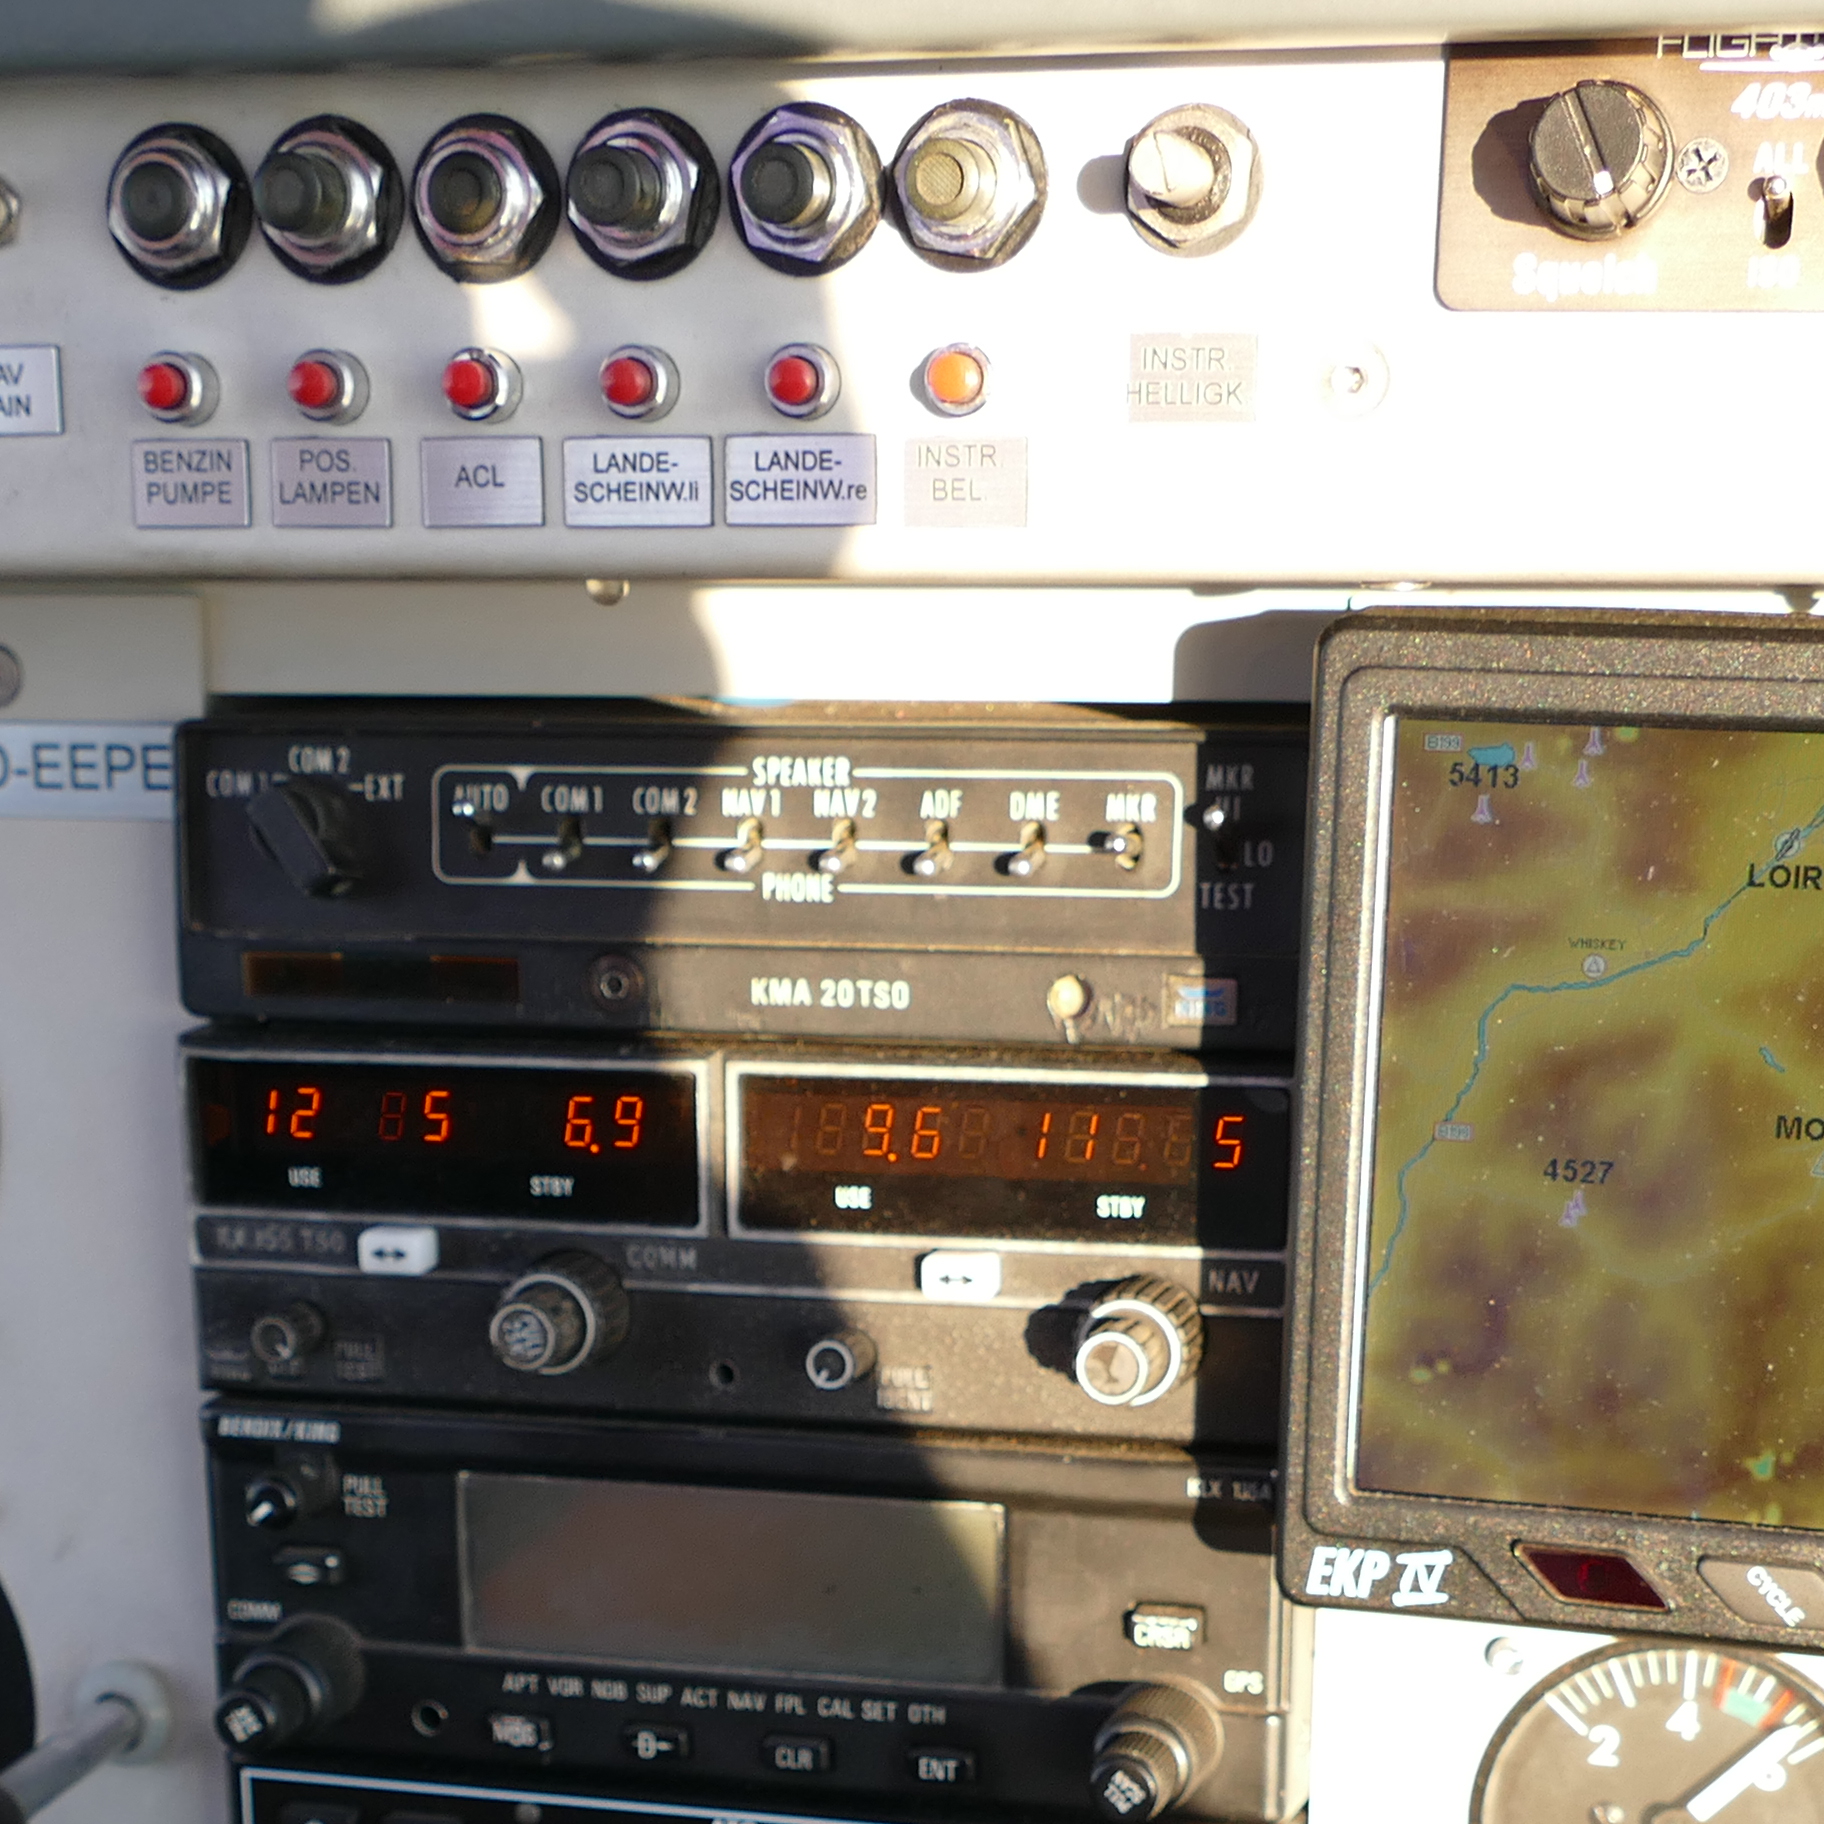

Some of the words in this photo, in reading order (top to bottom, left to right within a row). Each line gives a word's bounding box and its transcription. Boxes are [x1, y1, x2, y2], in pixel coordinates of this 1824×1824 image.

[143, 450, 233, 473] BENZIN
[298, 450, 357, 473] POS.
[592, 452, 680, 475] LANDE-
[754, 450, 842, 473] LANDE-
[454, 464, 505, 488] ACL
[146, 481, 233, 504] PUMPE
[279, 481, 380, 504] LAMPEN
[729, 478, 868, 503] SCHEINW.re
[288, 746, 333, 773] COM
[751, 756, 852, 788] SPEAKER
[363, 774, 406, 801] EXT
[1206, 764, 1255, 791] MKR
[1449, 762, 1520, 790] 5413
[541, 785, 589, 812] COM
[632, 787, 680, 815] COM
[721, 788, 765, 818] NAV
[813, 788, 858, 819] NAV
[919, 790, 964, 820] ADF
[1009, 791, 1062, 821] DME
[1105, 793, 1158, 823] MKR
[761, 872, 836, 904] PHONE
[1747, 863, 1824, 891] LOIR
[1200, 883, 1257, 910] TEST
[750, 977, 814, 1007] KMA
[288, 1166, 322, 1188] USE
[1543, 1158, 1615, 1185] 4527
[529, 1175, 575, 1197] STBY
[1208, 1270, 1261, 1295] NAV
[1305, 1546, 1391, 1600] EKP
[1746, 1565, 1807, 1628] CYCLE
[680, 1687, 719, 1710] ACT
[726, 1690, 766, 1713] NAV
[817, 1696, 855, 1719] CAL
[861, 1699, 899, 1723] SET
[918, 1756, 961, 1783] ENT
